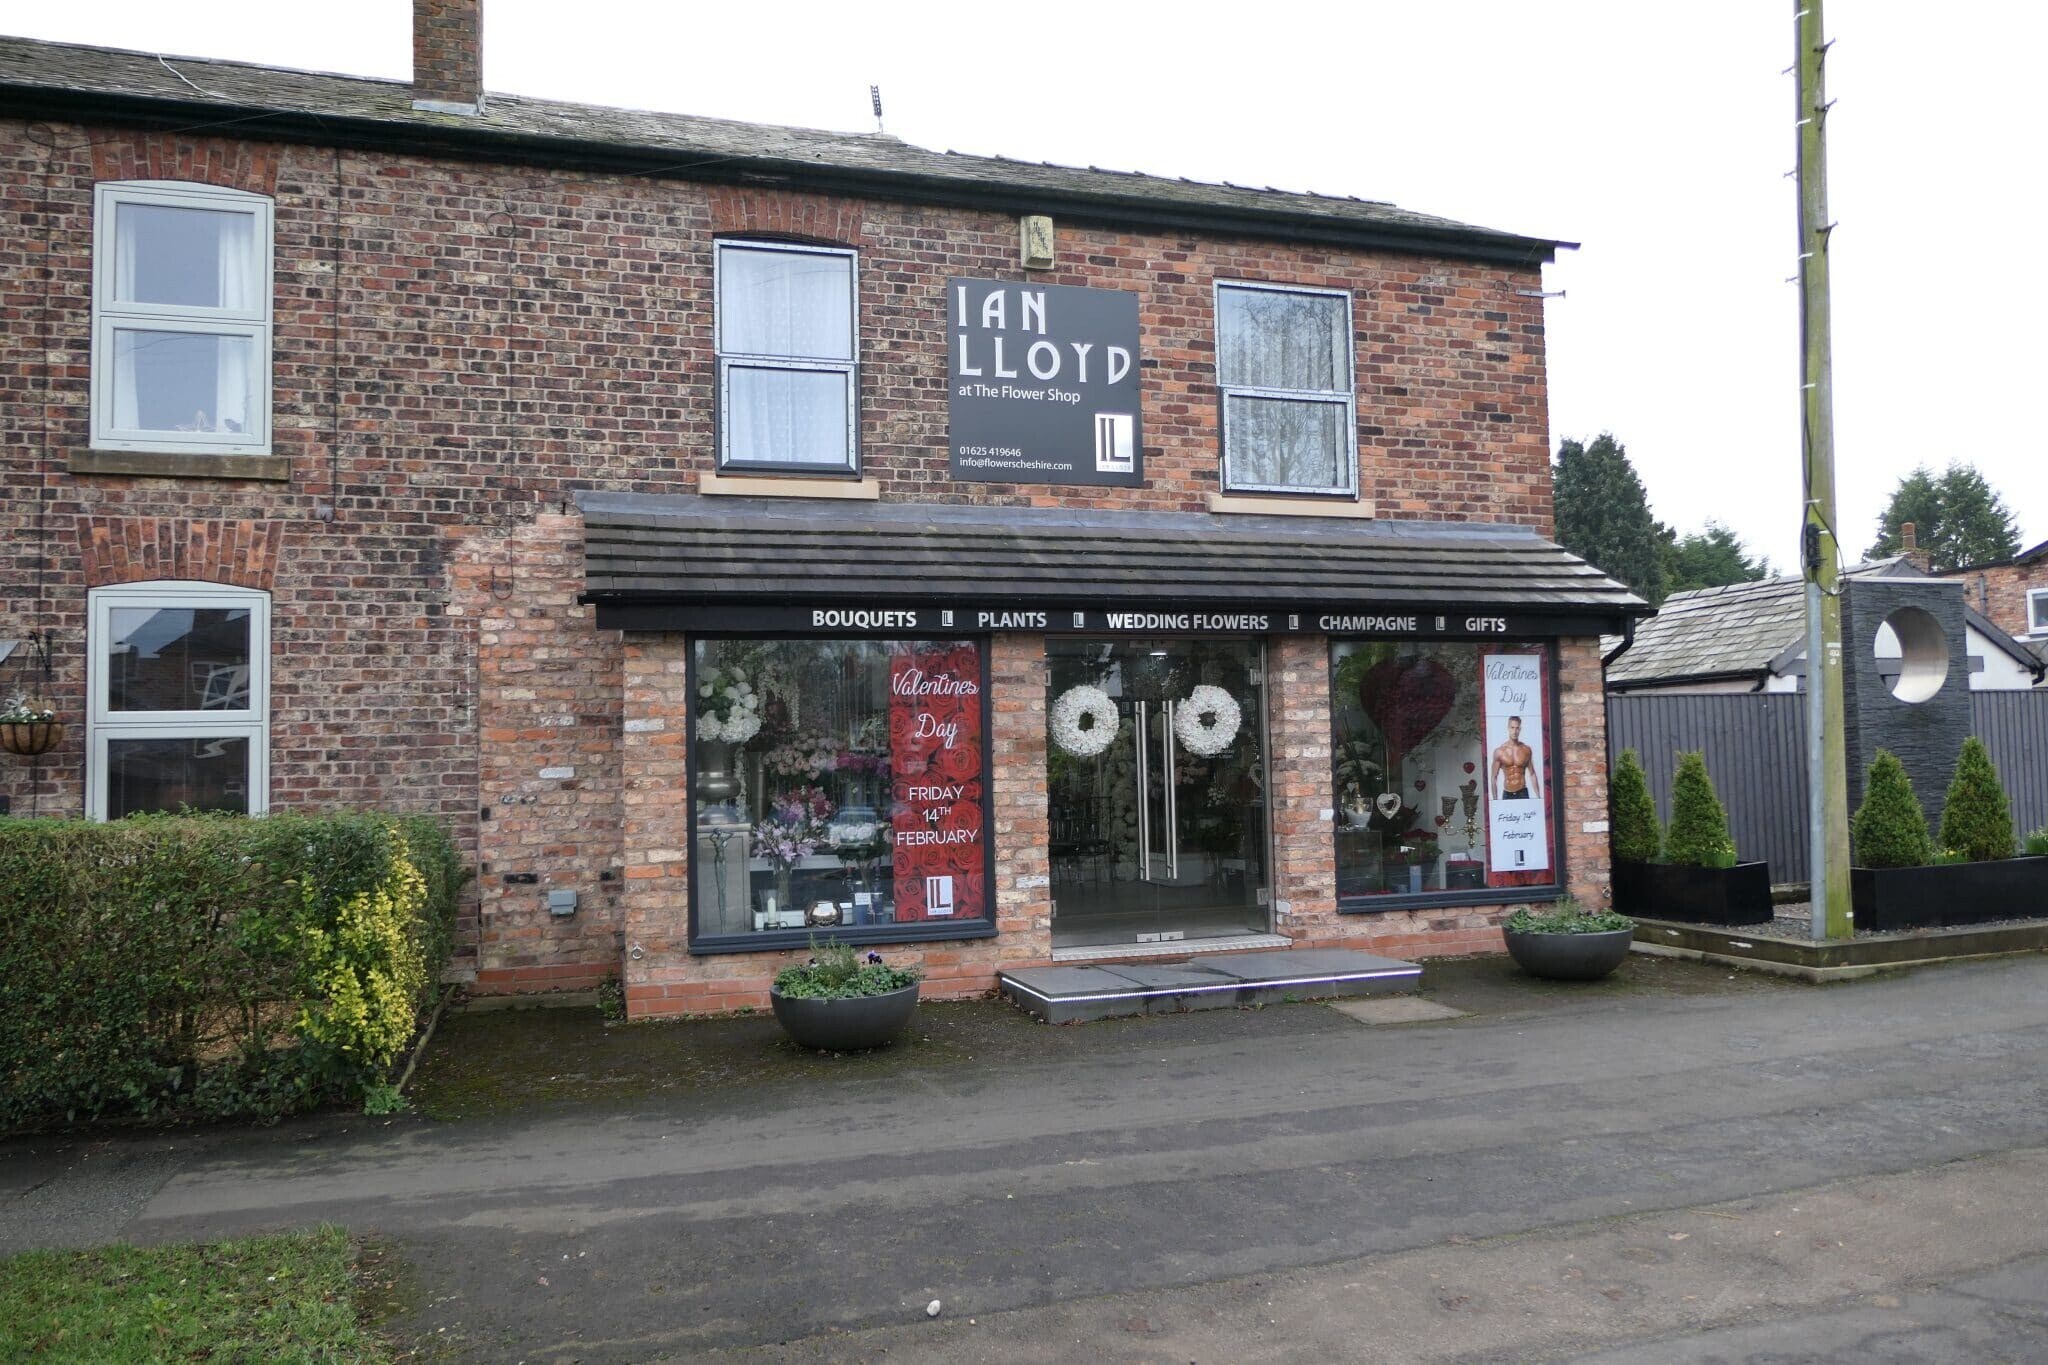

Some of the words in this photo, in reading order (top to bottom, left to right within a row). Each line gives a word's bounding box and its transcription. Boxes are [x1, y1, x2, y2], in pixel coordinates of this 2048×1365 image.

[957, 286, 1047, 335] IAN
[958, 334, 1131, 385] LLOYD
[959, 385, 972, 397] at
[974, 385, 998, 398] The
[1002, 386, 1045, 401] Flower
[1047, 389, 1081, 405] Shop
[959, 446, 987, 456] 01625
[988, 448, 1021, 457] 419646
[959, 458, 1073, 472] info@flowerscheshire.com
[812, 610, 917, 628] BOUQUETS
[978, 612, 1047, 628] PLANTS
[1107, 613, 1190, 630] WEDDING
[1193, 614, 1269, 630] FLOWERS
[1319, 615, 1416, 631] CHAMPAGNE
[1465, 617, 1506, 632] GIFTS
[1486, 661, 1538, 680] Valentines
[893, 668, 980, 696] Valentines
[1500, 685, 1528, 711] Day
[915, 712, 958, 749] Day
[908, 785, 965, 801] FRIDAY
[1498, 813, 1521, 824] Friday
[897, 829, 978, 846] FEBRUARY
[1503, 831, 1534, 840] February
